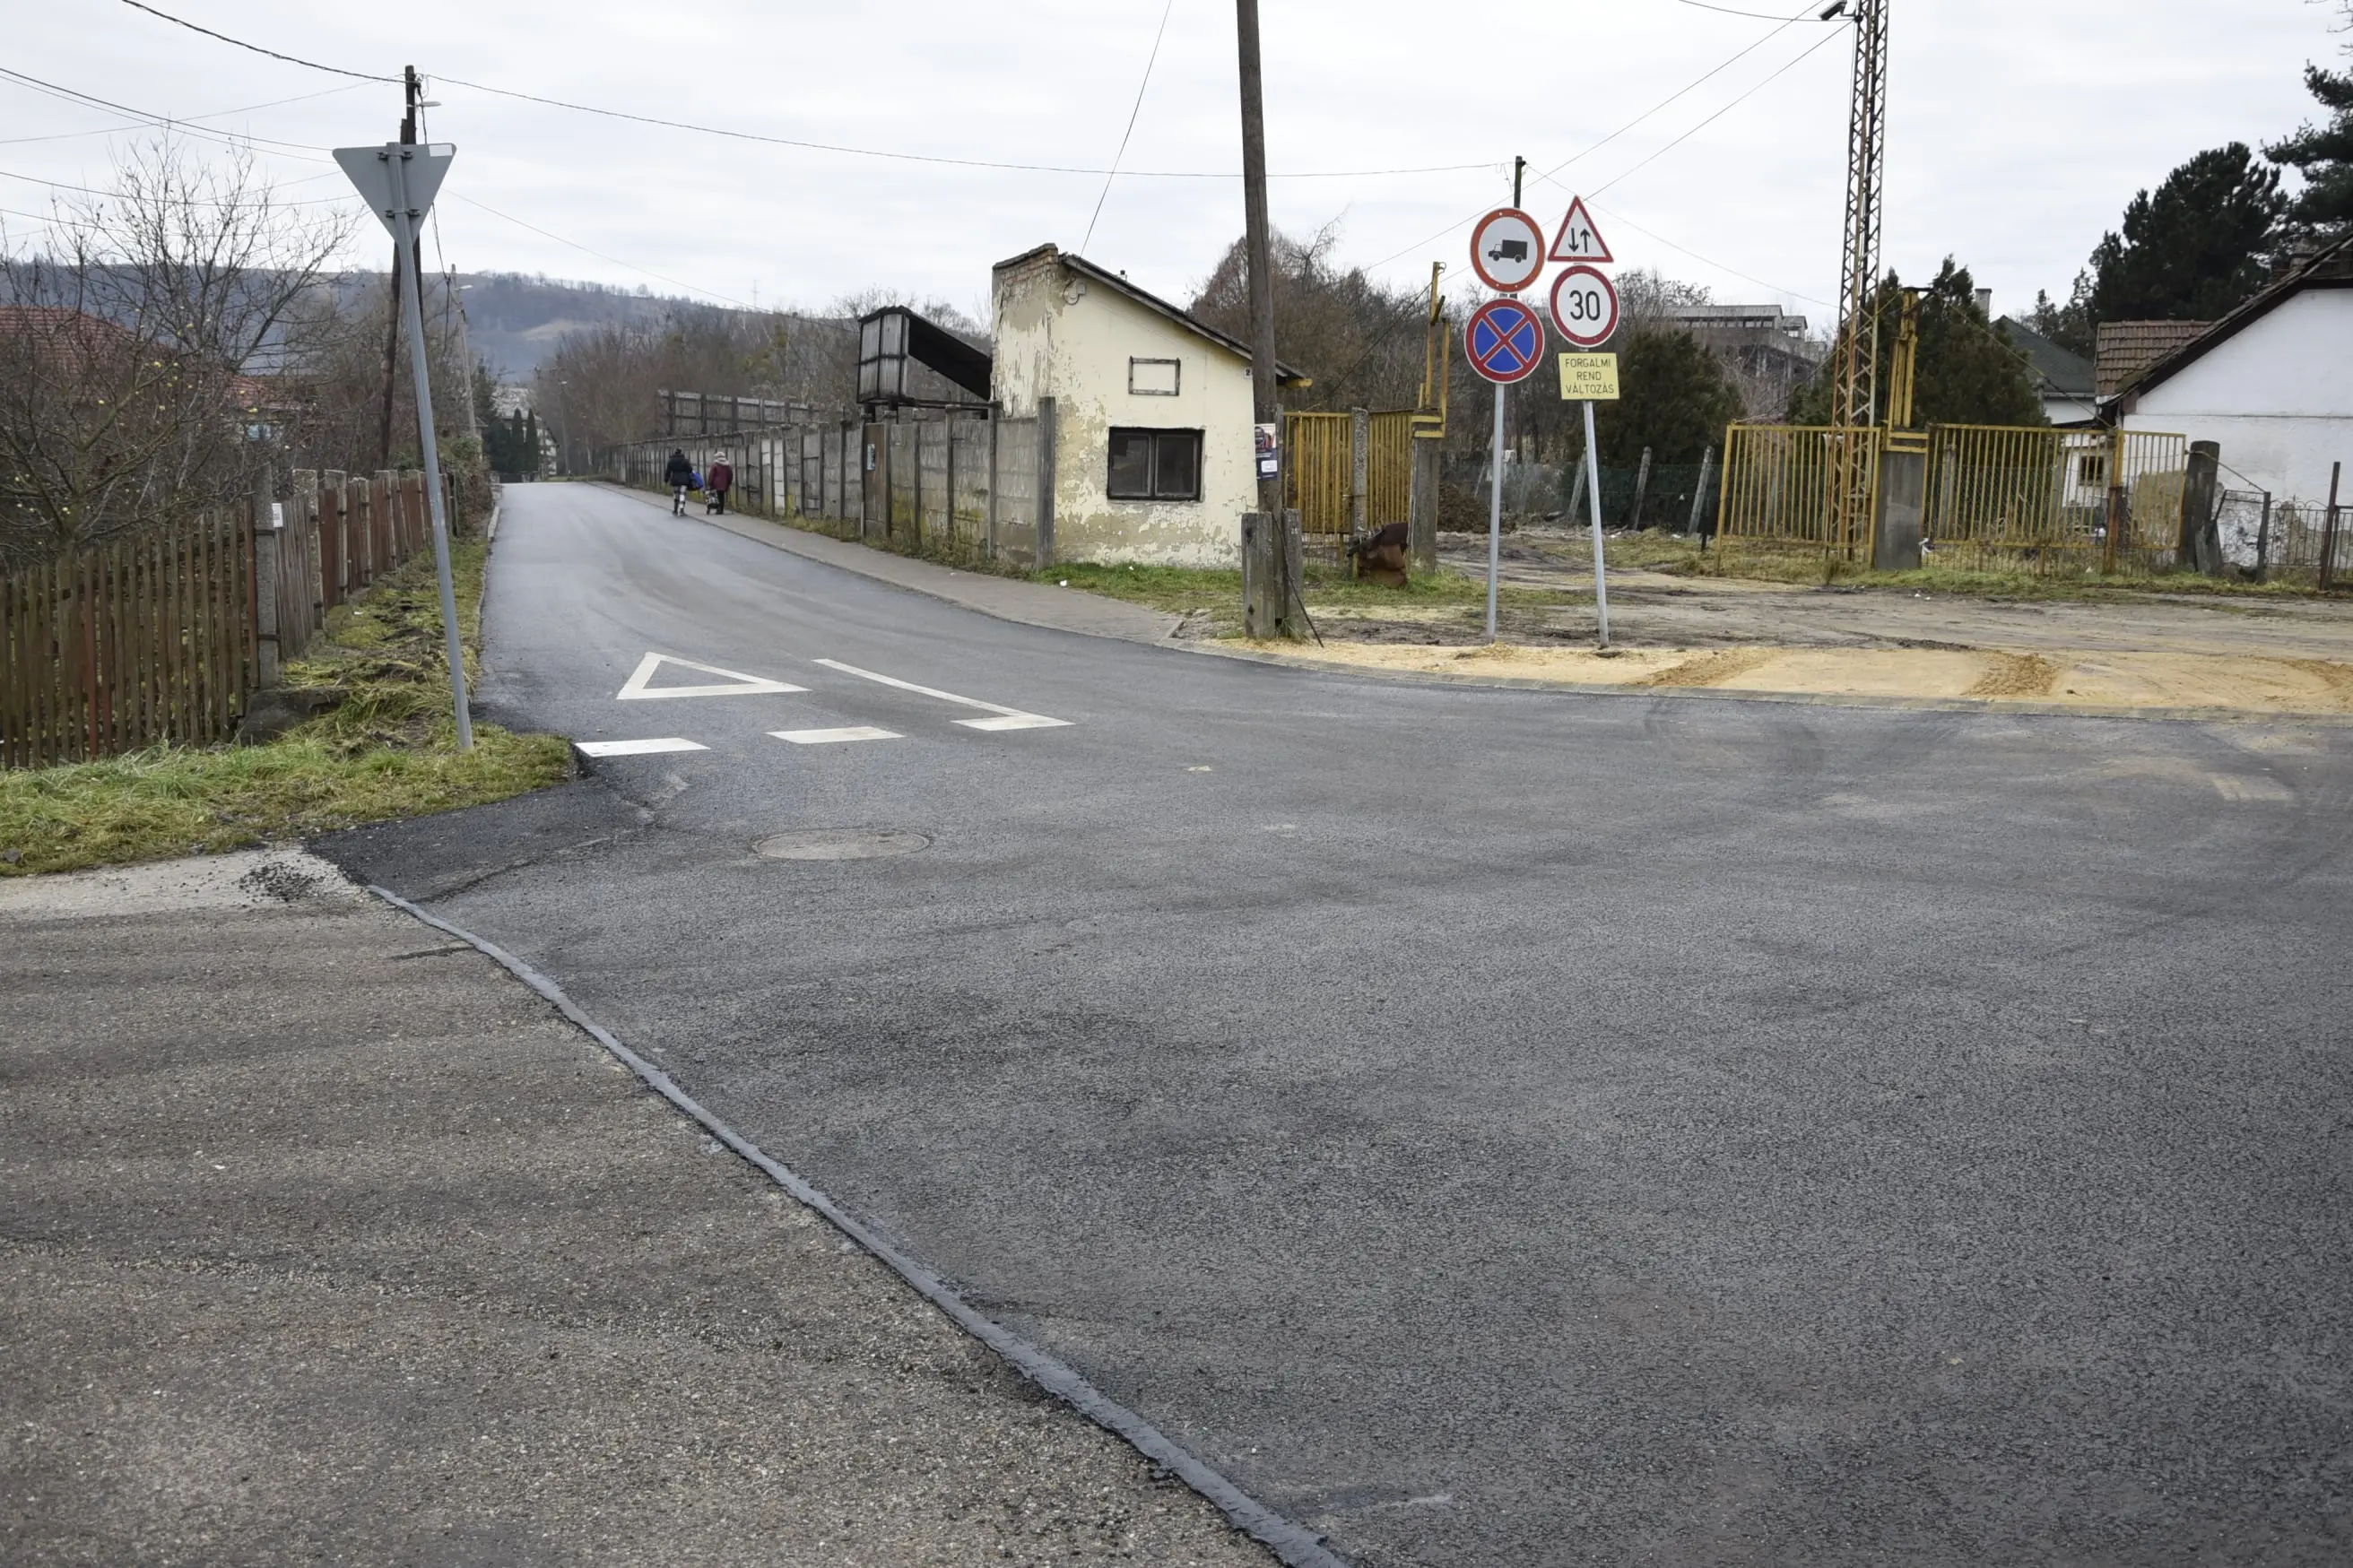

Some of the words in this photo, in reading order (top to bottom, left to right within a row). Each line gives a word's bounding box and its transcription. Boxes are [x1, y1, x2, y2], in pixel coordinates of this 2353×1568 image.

[1569, 290, 1601, 321] 30
[1565, 358, 1611, 368] FORGALMI
[1576, 371, 1602, 380] REND
[1565, 382, 1614, 394] VÁLTOZÁS
